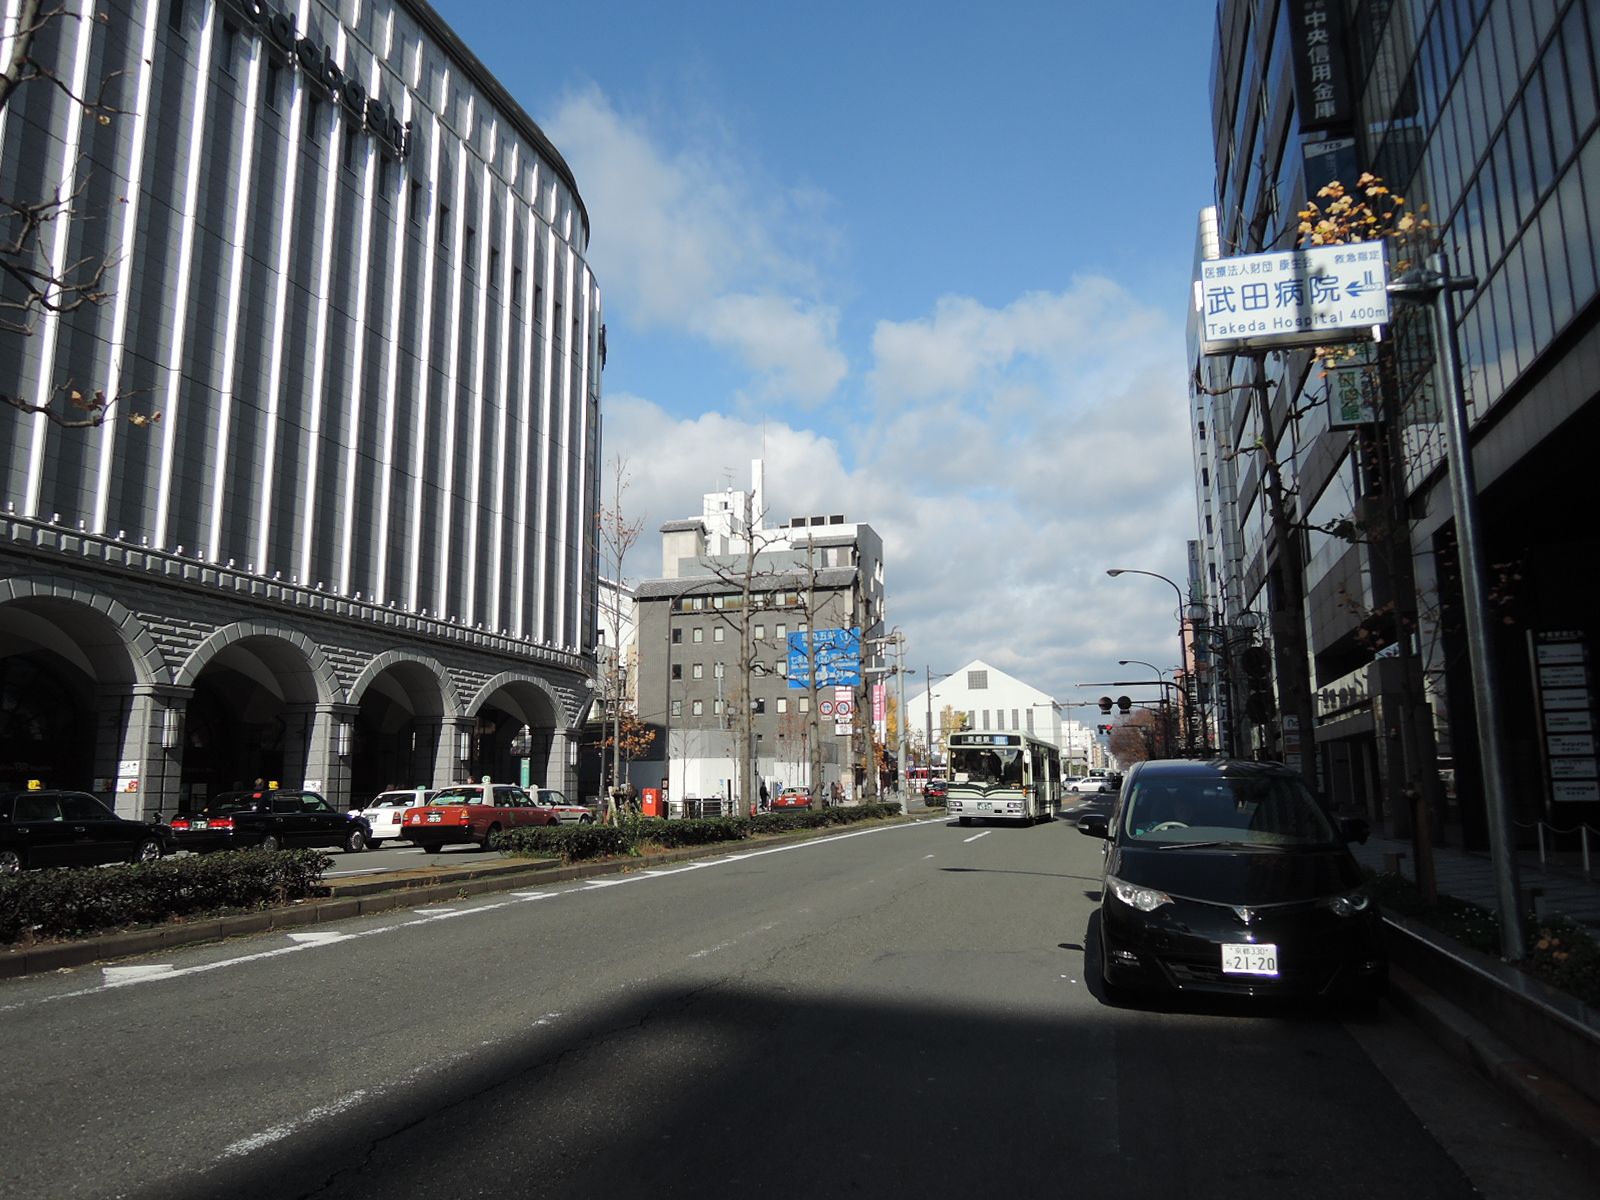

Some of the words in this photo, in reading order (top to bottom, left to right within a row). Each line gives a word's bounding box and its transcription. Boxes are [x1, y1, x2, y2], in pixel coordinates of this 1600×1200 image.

[1334, 251, 1380, 265] 救急指定
[1204, 261, 1273, 278] 医療法人財団
[1206, 274, 1341, 316] 武田病院
[1208, 321, 1266, 336] Takeda
[1273, 310, 1343, 330] Hospital
[1350, 308, 1386, 320] 400m
[1234, 956, 1275, 970] 21-20
